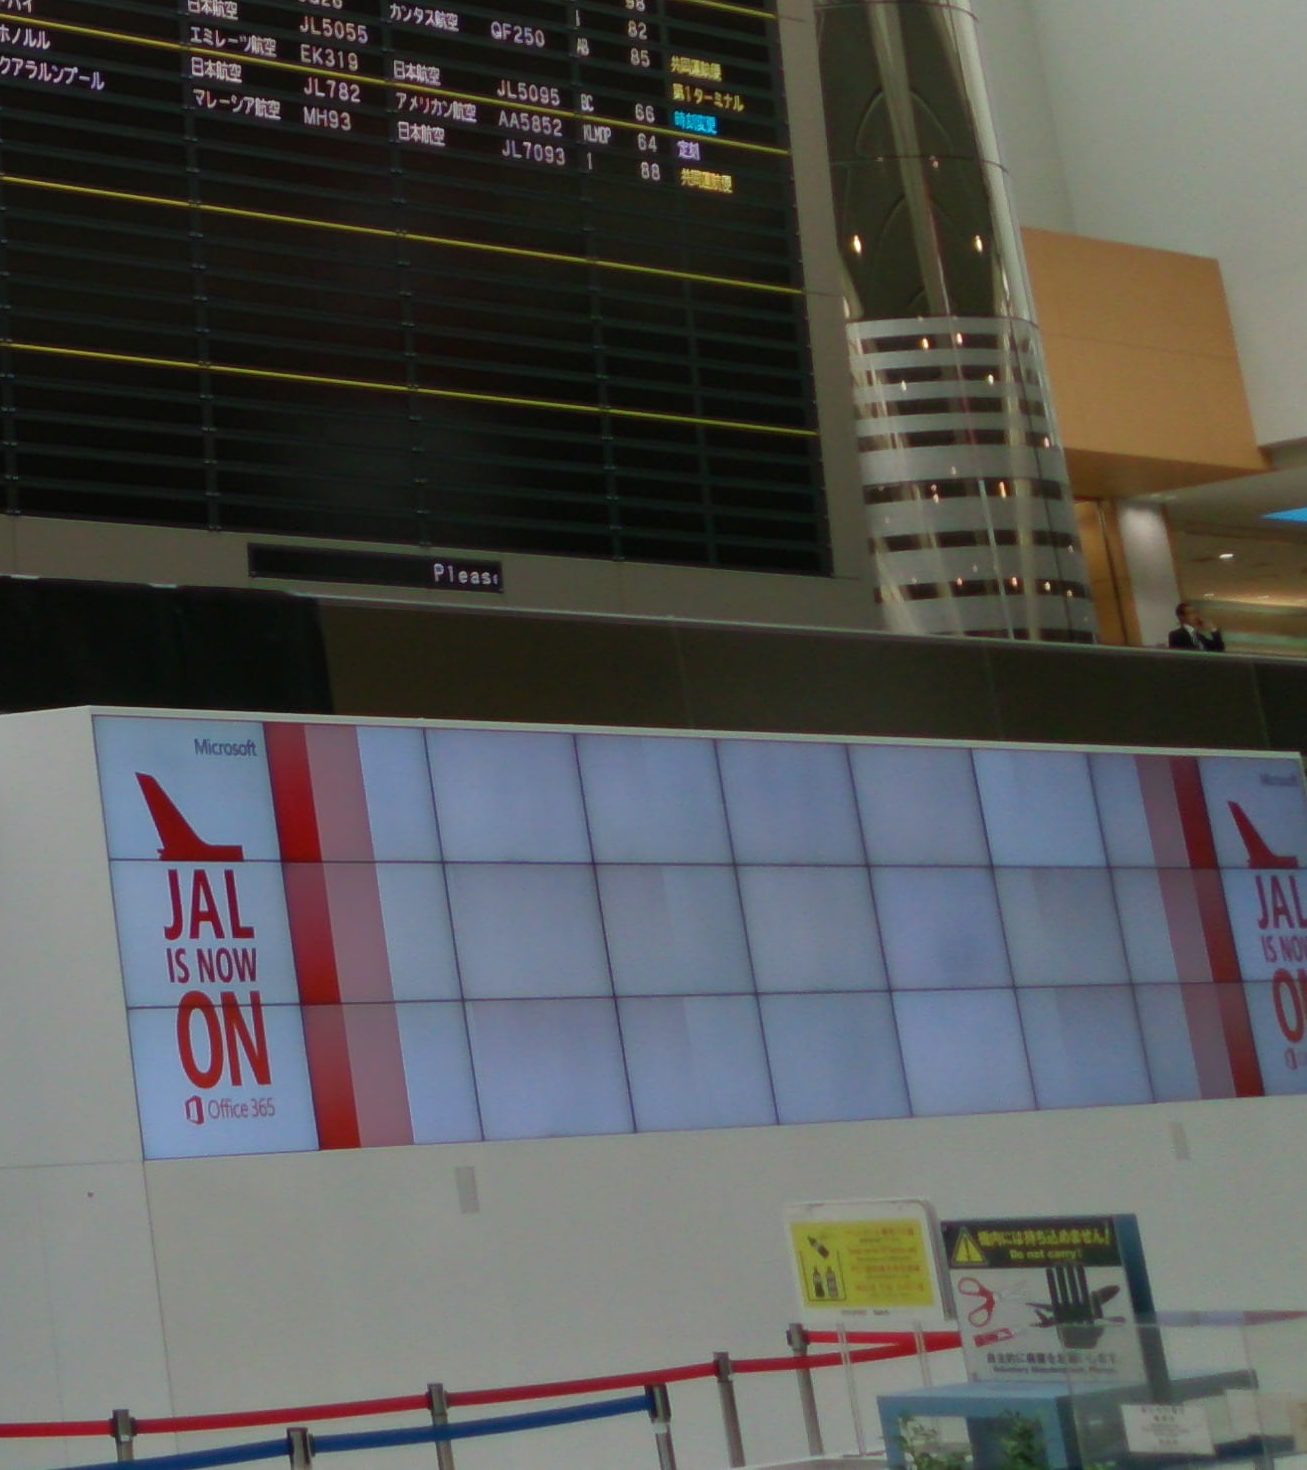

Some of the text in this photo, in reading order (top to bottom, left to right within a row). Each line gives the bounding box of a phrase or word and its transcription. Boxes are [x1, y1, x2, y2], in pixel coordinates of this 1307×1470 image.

[298, 14, 370, 45] JL5055
[299, 42, 360, 72] EK319
[193, 737, 258, 758] Microsoft
[163, 868, 256, 941] JAL
[1280, 934, 1307, 964] NO
[165, 946, 258, 984] IS NOW
[1271, 967, 1307, 1044] O
[175, 989, 273, 1090] ON
[207, 1096, 276, 1121] Office 365
